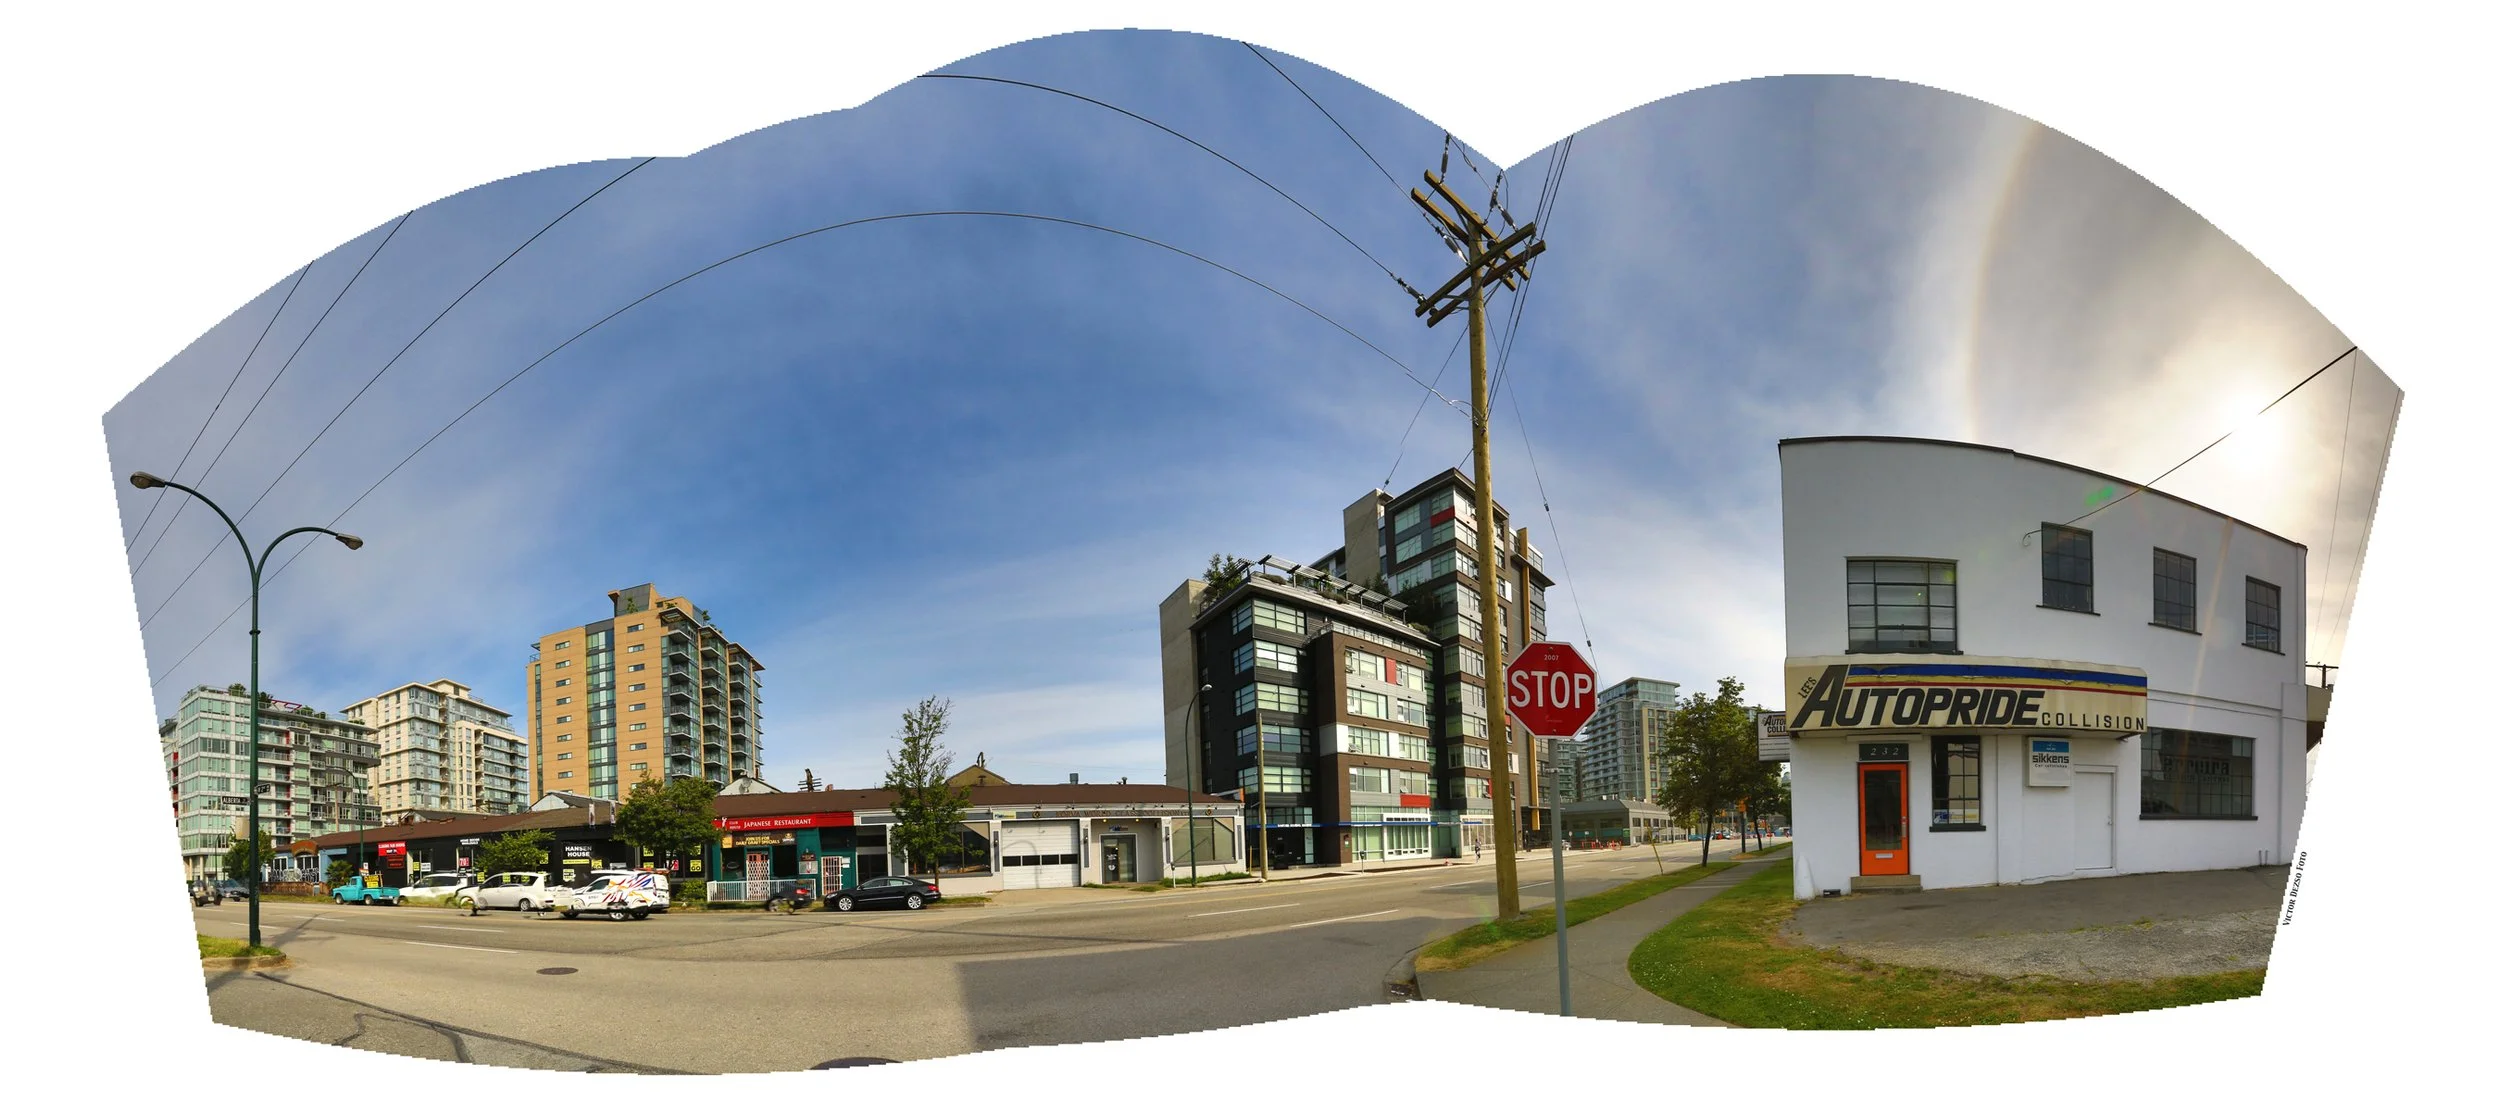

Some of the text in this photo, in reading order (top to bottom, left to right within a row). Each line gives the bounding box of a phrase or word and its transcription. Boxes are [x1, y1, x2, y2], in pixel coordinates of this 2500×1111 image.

[1511, 670, 1593, 709] STOP
[1790, 664, 2144, 731] LEE'S AUTOPRIDE COLLISION
[1870, 747, 1899, 756] 232
[2032, 753, 2070, 764] sikkens
[743, 818, 812, 829] JAPANESE RESTAURANT
